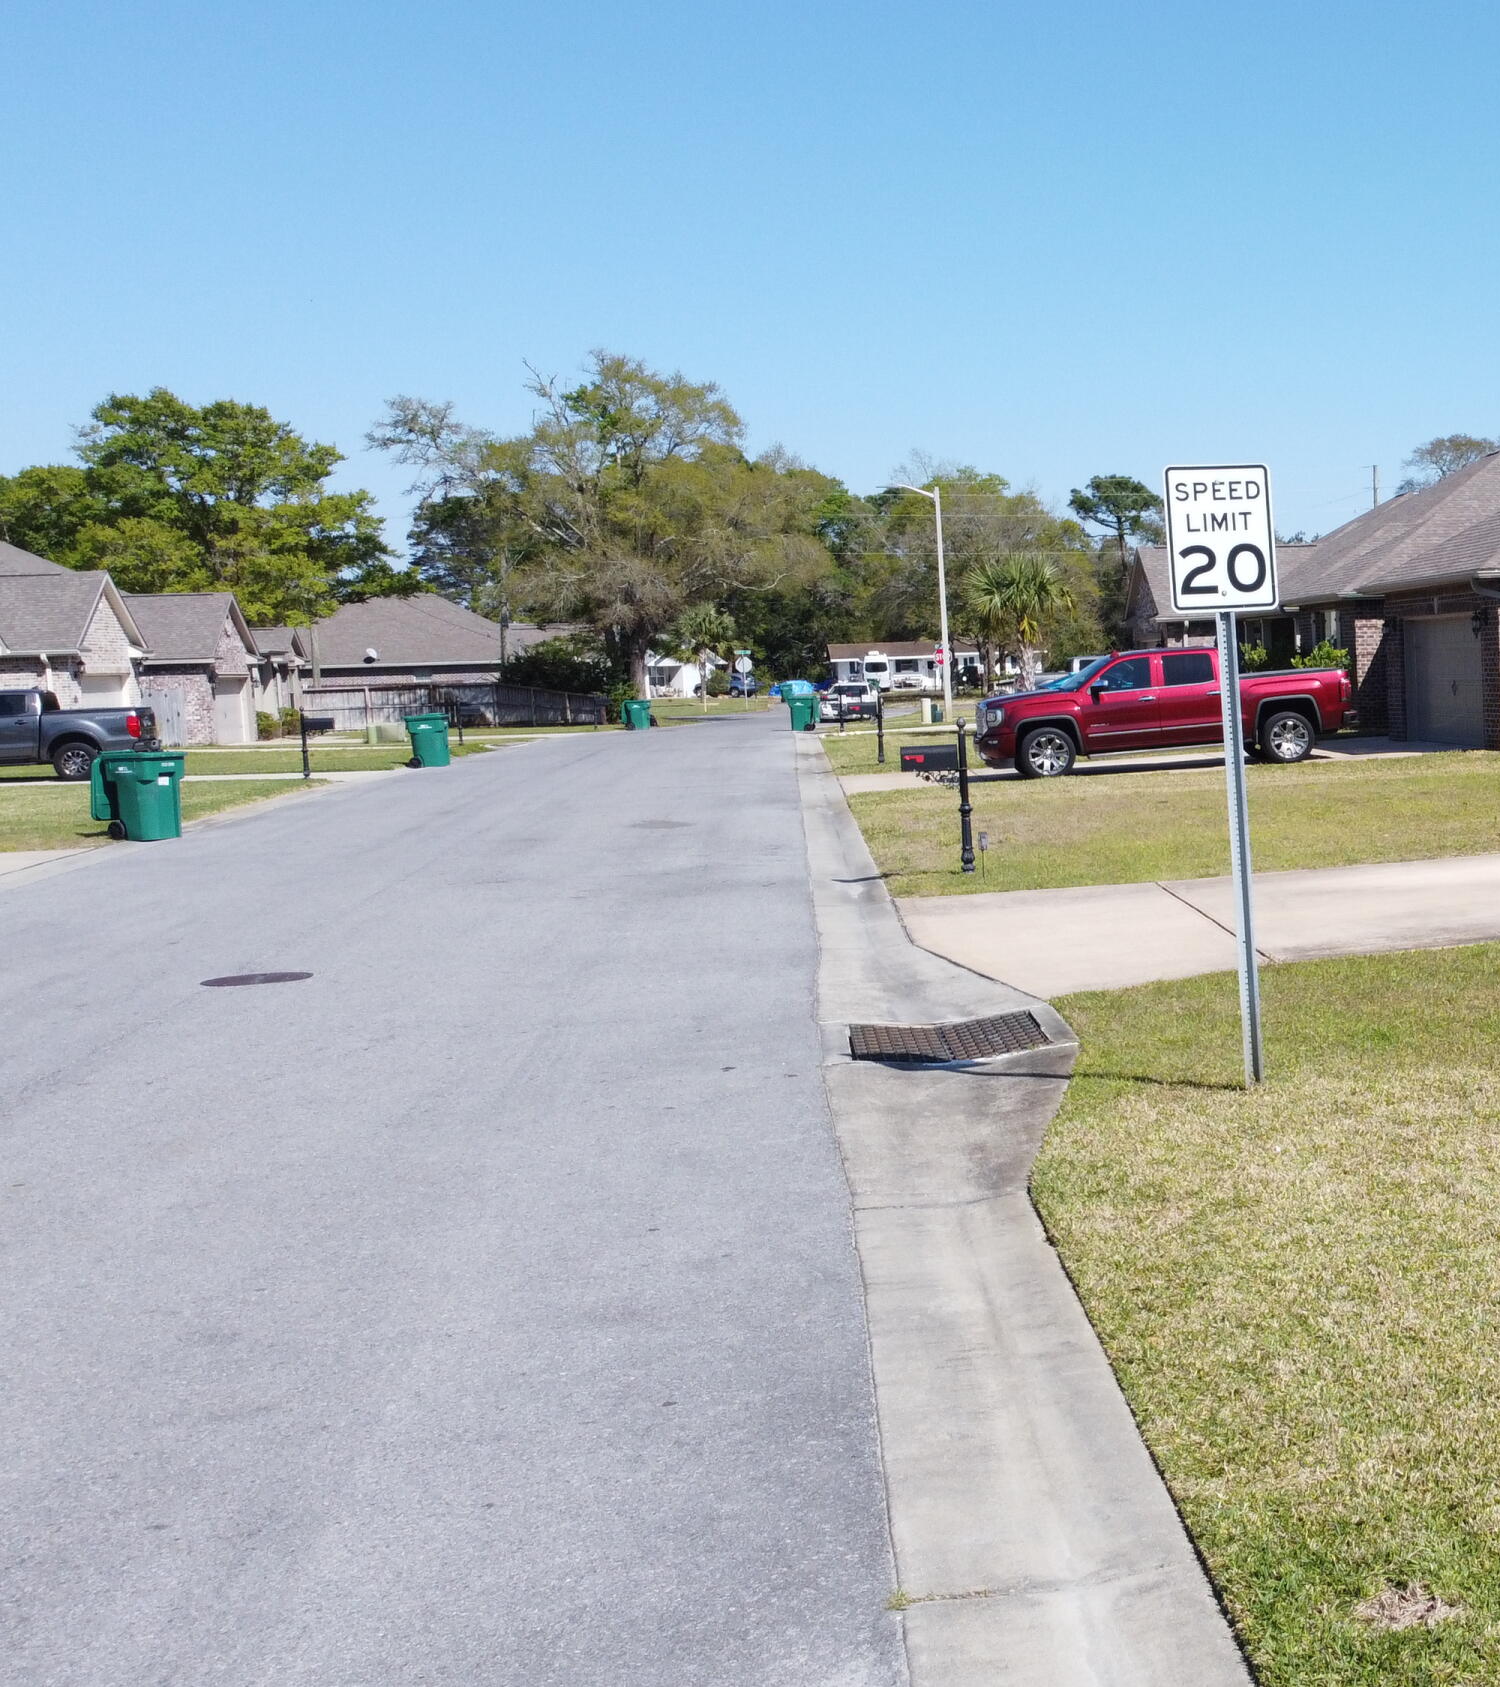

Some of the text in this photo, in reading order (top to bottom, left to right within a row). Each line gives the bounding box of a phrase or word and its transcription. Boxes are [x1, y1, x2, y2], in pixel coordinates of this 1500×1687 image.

[1175, 481, 1260, 501] SPEED
[1186, 512, 1252, 532] LIMIT
[1178, 543, 1267, 595] 20
